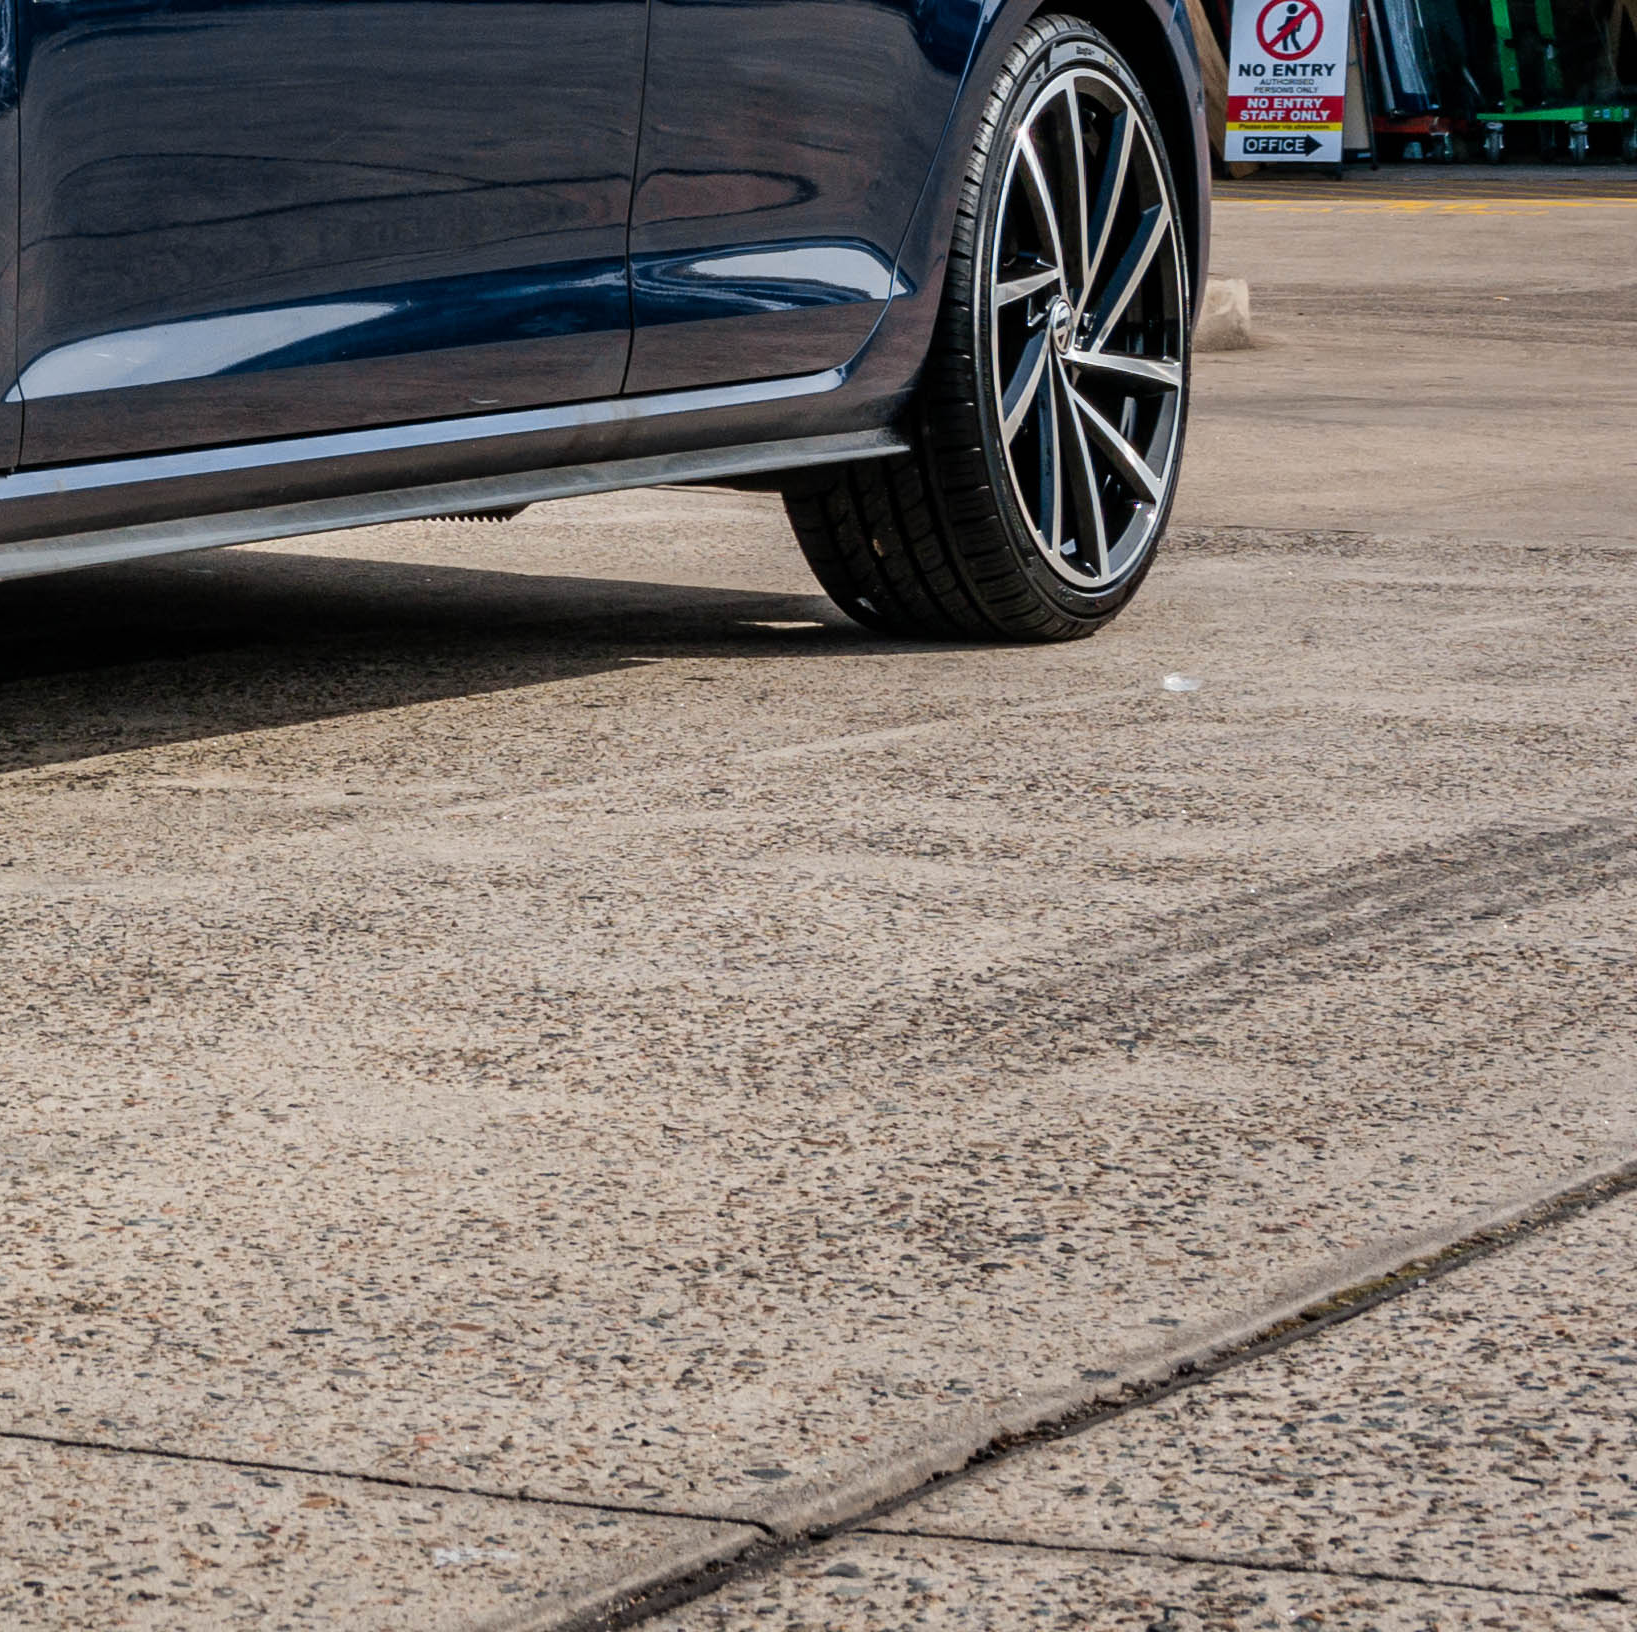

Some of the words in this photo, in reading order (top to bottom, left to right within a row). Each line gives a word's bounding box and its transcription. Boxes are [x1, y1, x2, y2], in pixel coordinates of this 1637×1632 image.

[1238, 64, 1266, 77] NO
[1272, 63, 1336, 77] ENTRY
[1253, 86, 1294, 94] PERSONS
[1296, 86, 1319, 94] ONLY
[1247, 97, 1269, 109] NO
[1273, 97, 1324, 109] ENTRY
[1239, 109, 1286, 121] STAFF
[1289, 109, 1331, 121] ONLY
[1245, 138, 1306, 152] OFFICE
